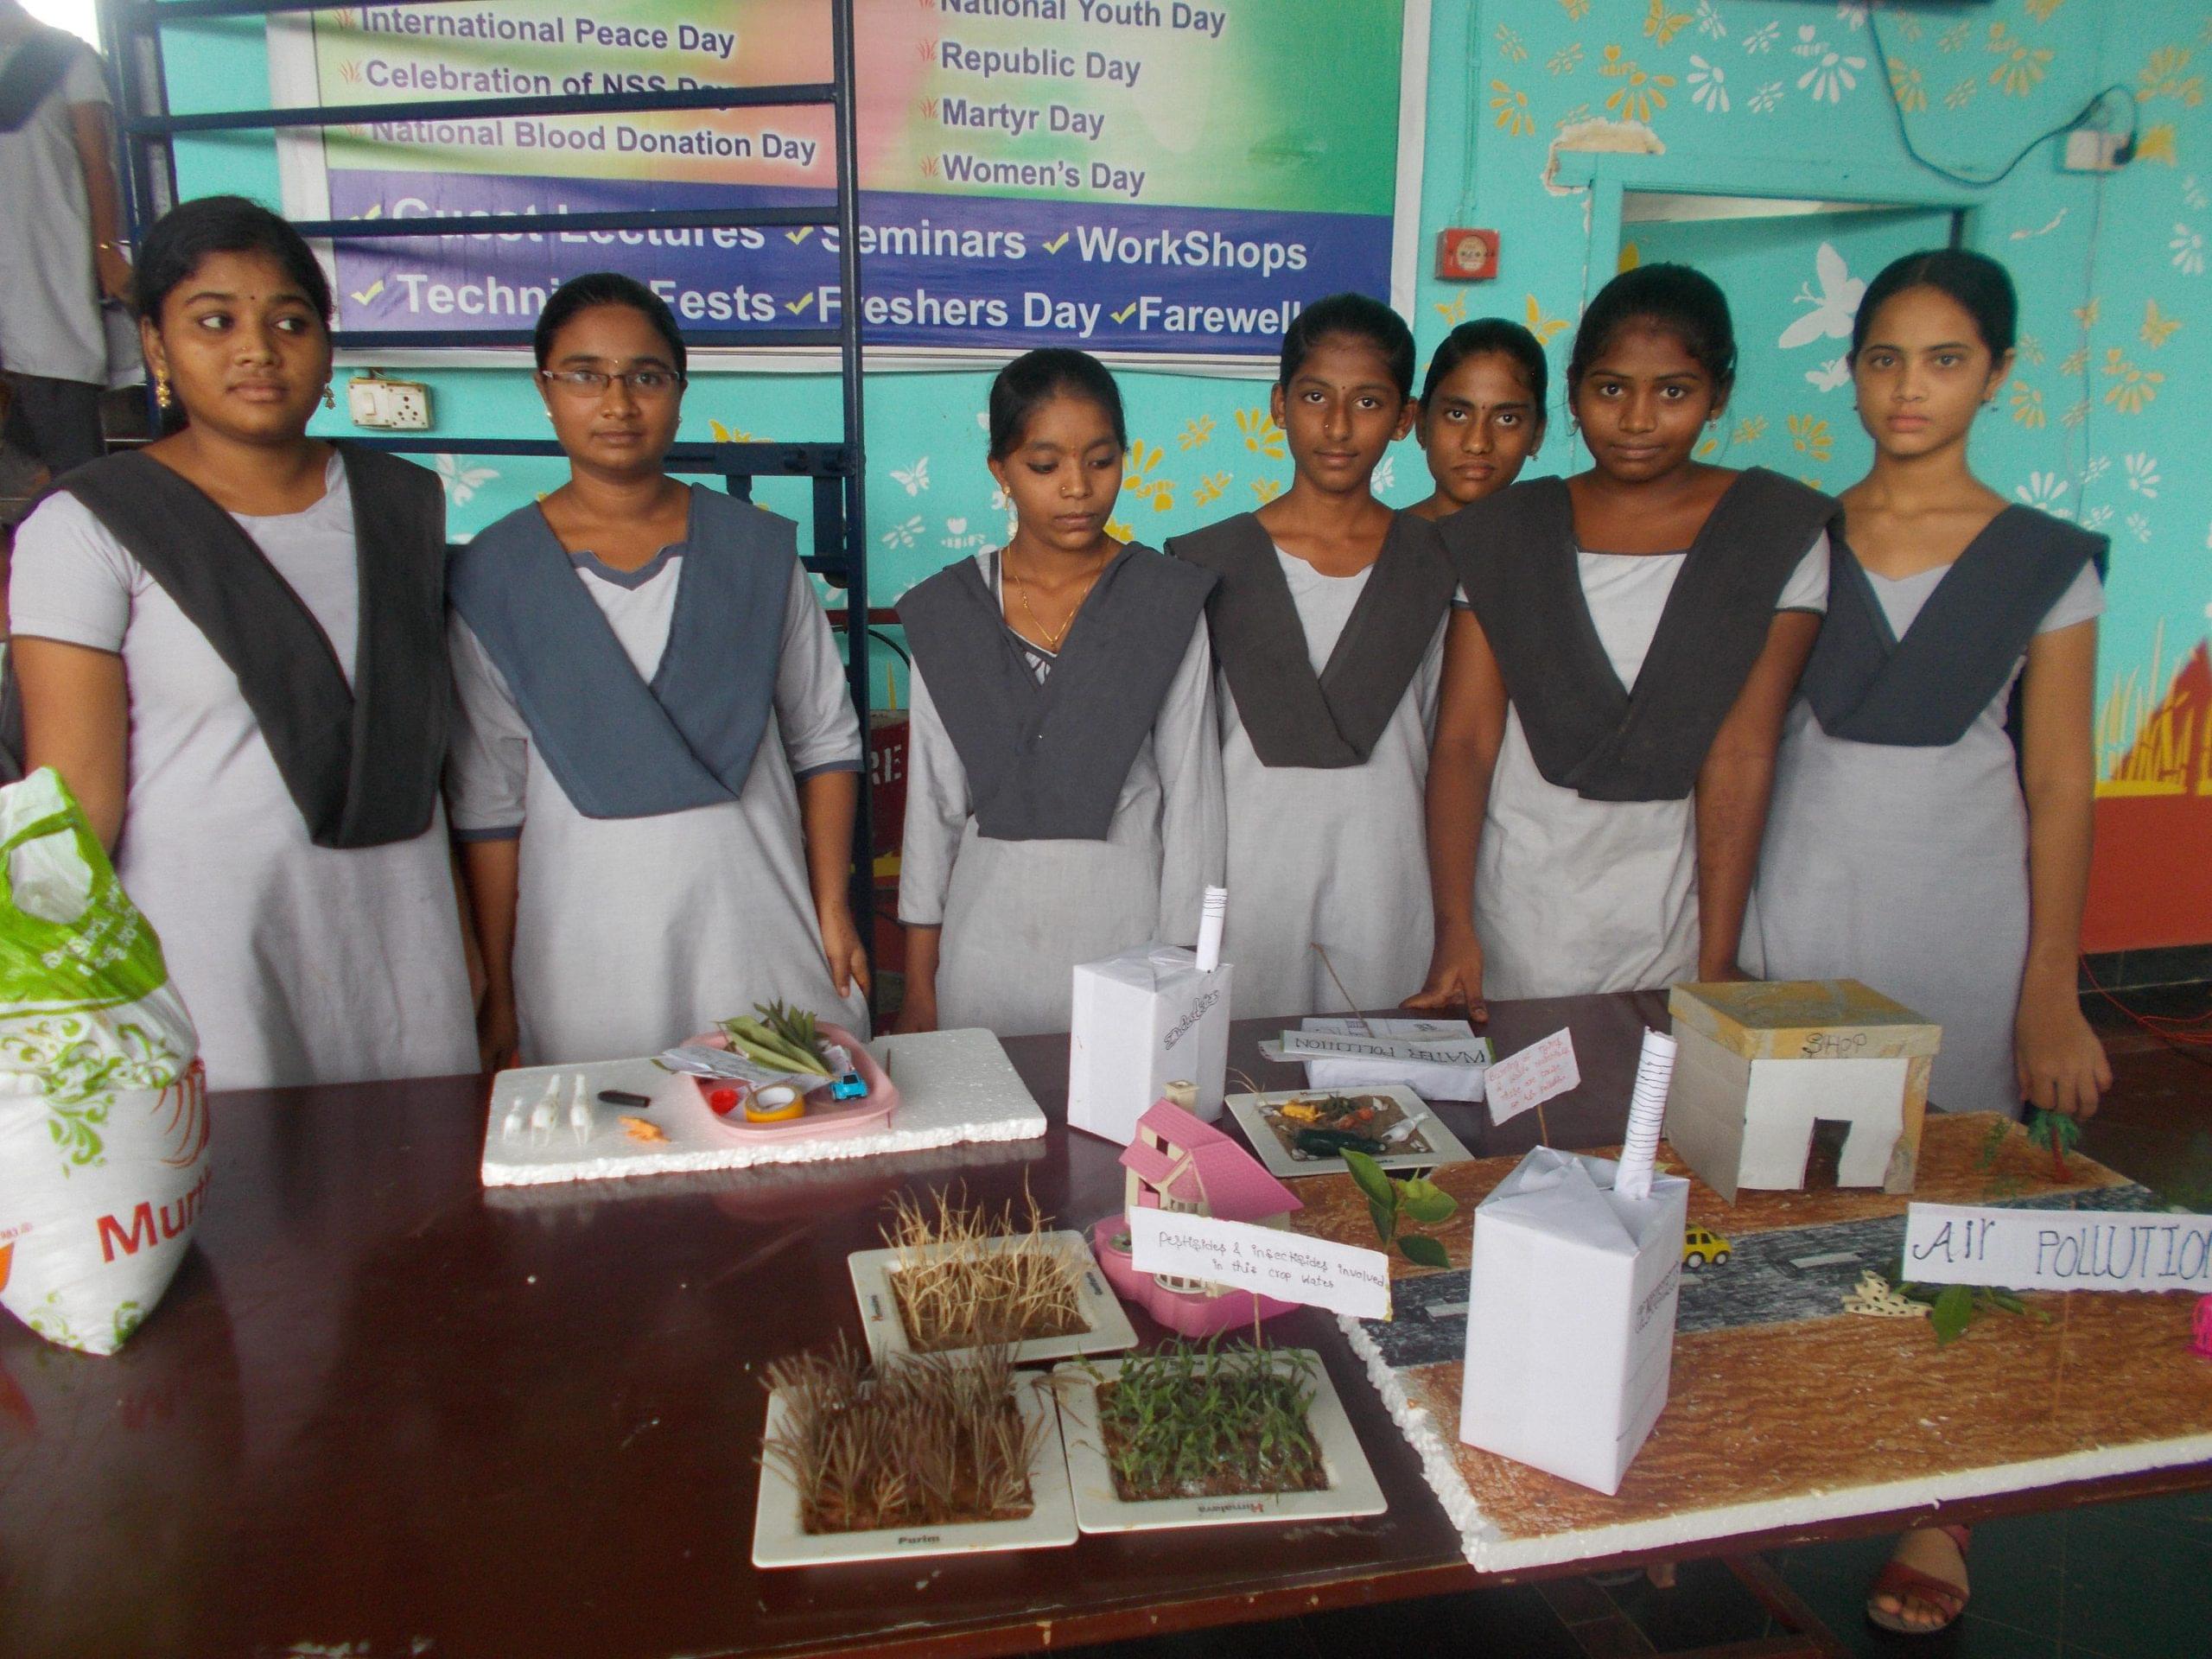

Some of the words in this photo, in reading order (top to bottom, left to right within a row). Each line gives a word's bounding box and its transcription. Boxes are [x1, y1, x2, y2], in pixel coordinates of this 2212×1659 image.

[361, 7, 563, 42] International
[575, 17, 668, 48] Peace
[678, 24, 734, 59] Day
[1082, 0, 1160, 27] Youth
[1172, 3, 1226, 38] Day
[366, 60, 551, 95] Celebration
[563, 72, 593, 94] of
[602, 73, 665, 93] NSS
[942, 41, 1075, 78] Republic
[1086, 52, 1141, 87] Day
[943, 98, 1039, 136] Martyr
[1050, 105, 1105, 141] Day
[372, 119, 503, 146] National
[515, 121, 605, 150] Blood
[617, 125, 751, 157] Donation
[762, 133, 816, 166] Day
[943, 154, 1080, 188] Women's
[1091, 162, 1146, 198] Day
[1077, 226, 1307, 277] WorkShops
[818, 286, 1008, 326] Feshers
[1024, 292, 1102, 338] Day
[1296, 1037, 1395, 1058] POLLUTION
[1408, 1044, 1485, 1065] WATER
[1211, 1258, 1223, 1270] in
[1913, 1219, 1995, 1262] Air
[2035, 1224, 2212, 1280] POLLUTIO
